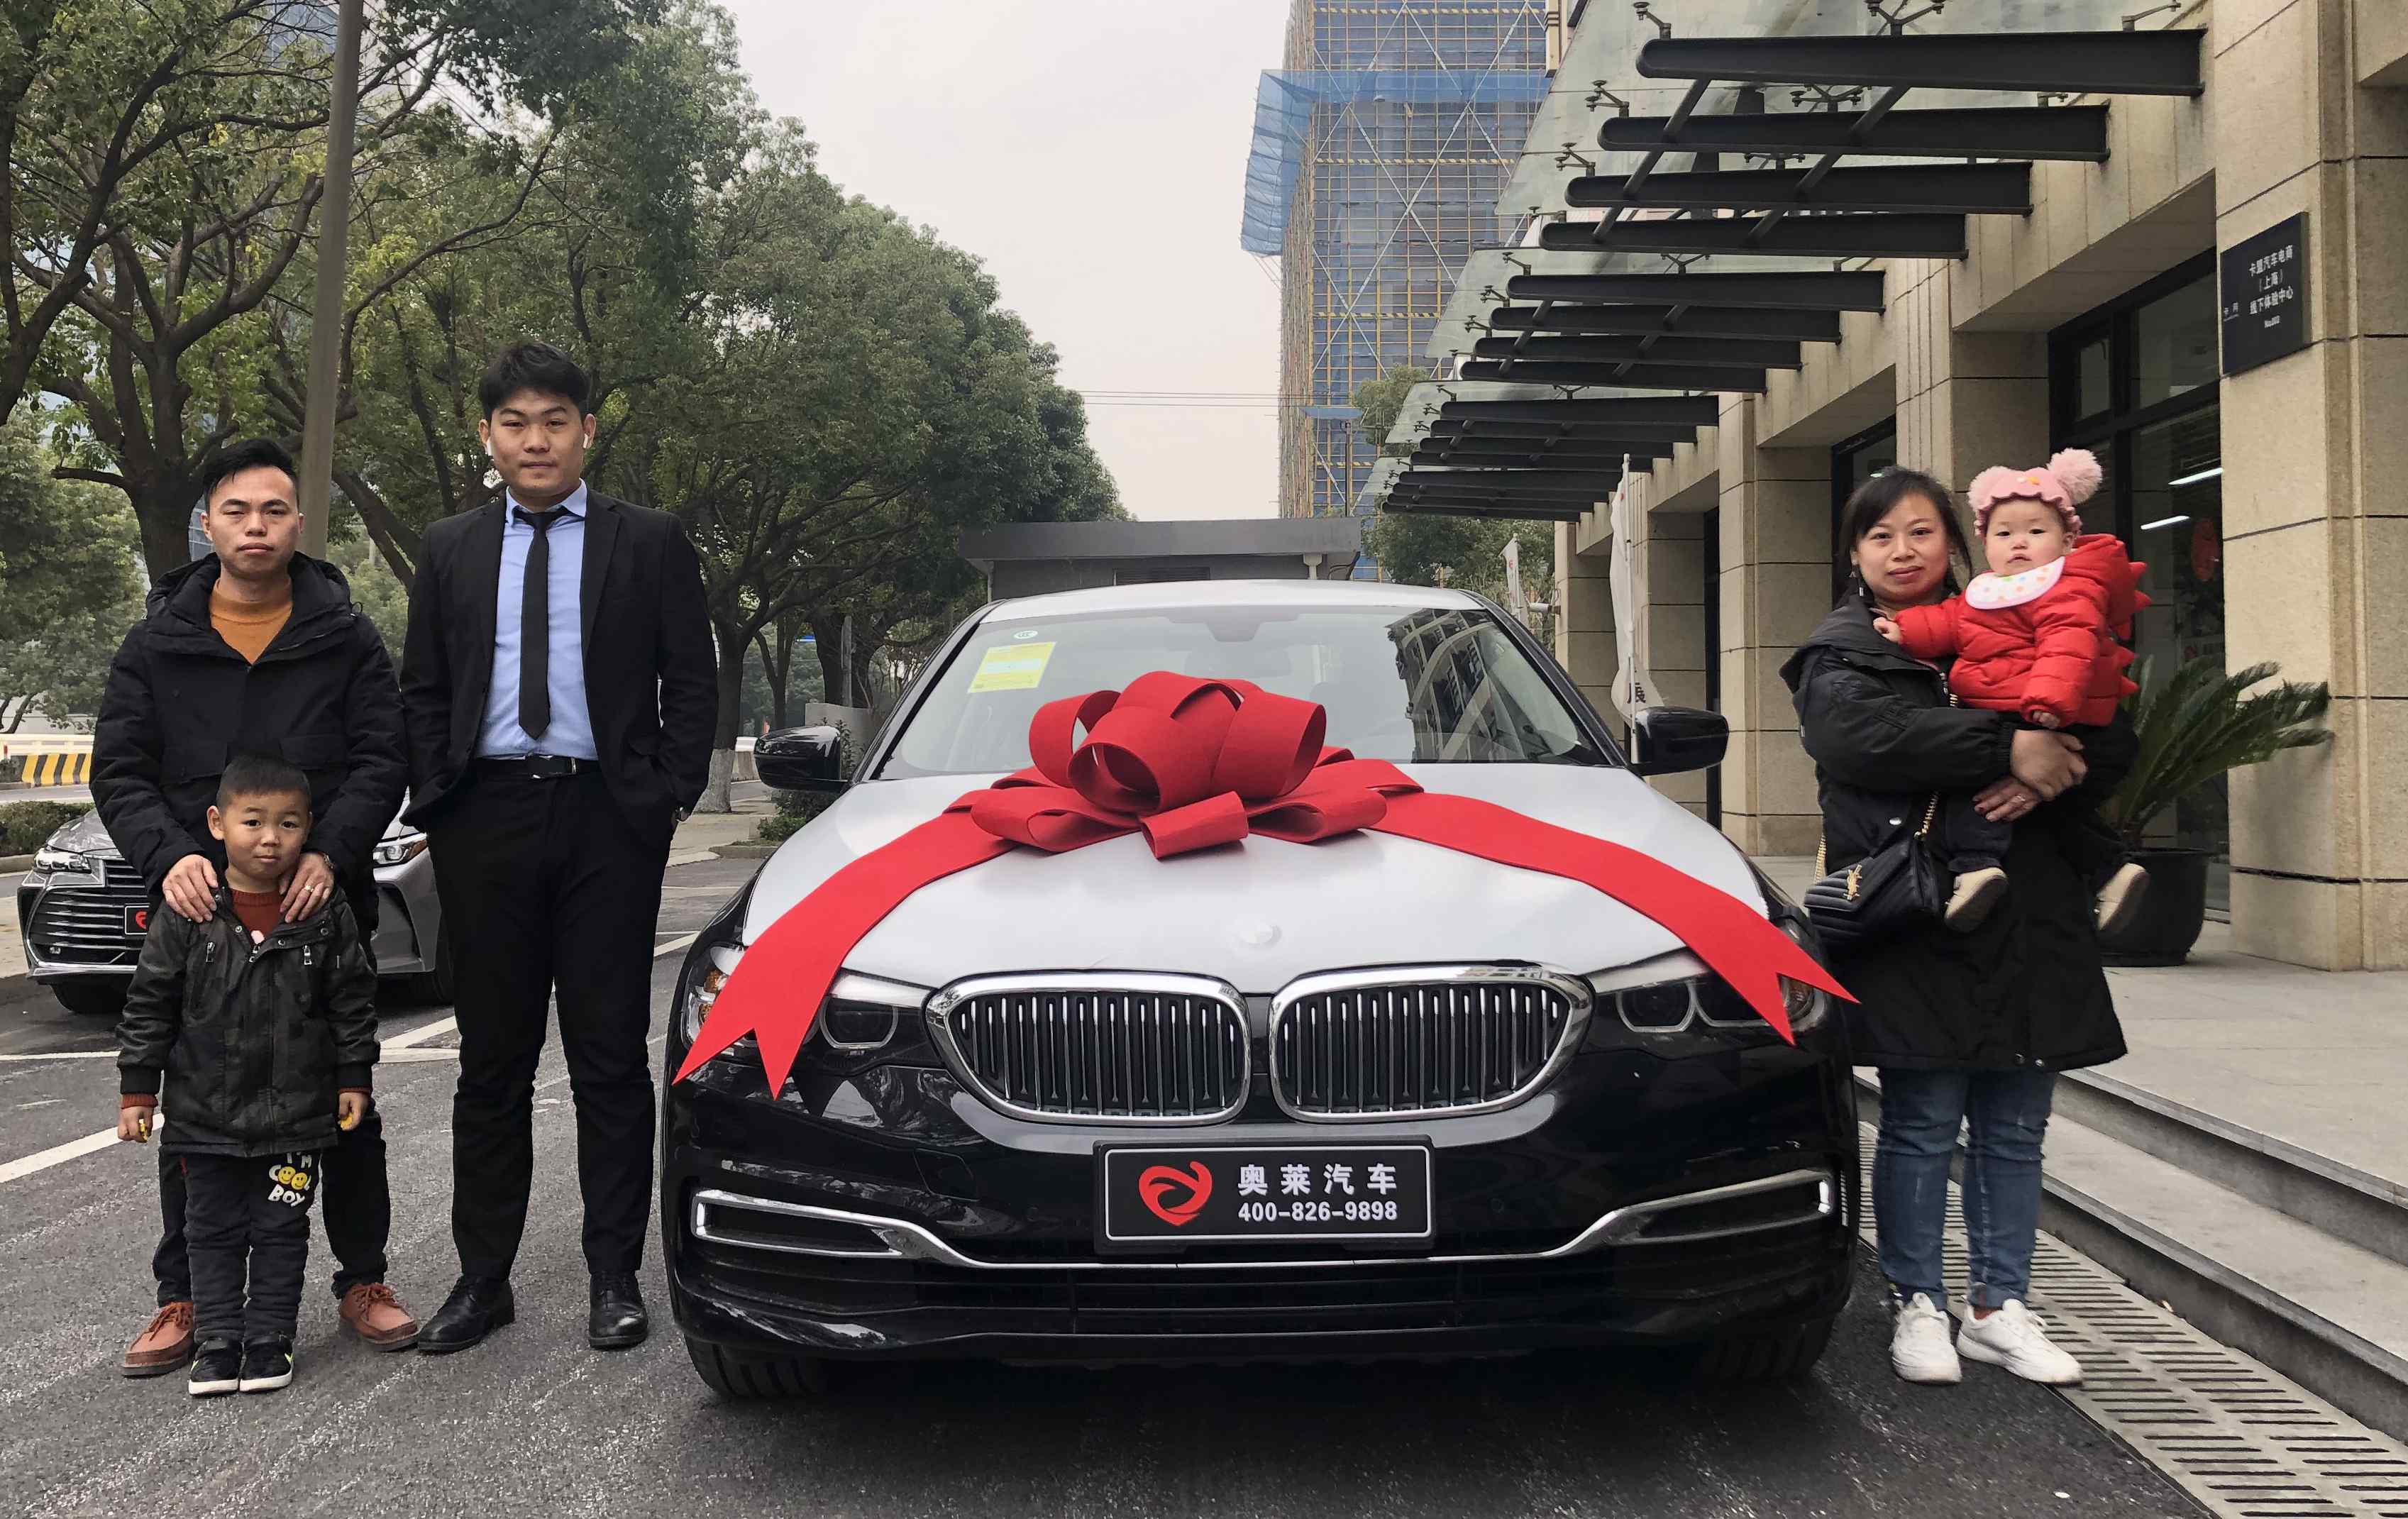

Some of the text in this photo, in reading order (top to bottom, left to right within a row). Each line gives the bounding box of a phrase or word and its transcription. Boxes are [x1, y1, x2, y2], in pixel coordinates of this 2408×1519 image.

[2249, 244, 2293, 277] 卡盟汽车电商
[2249, 285, 2294, 315] 线下体验中心
[1237, 1163, 1398, 1196] 奥莱汽车
[267, 1183, 306, 1208] BOY
[1237, 1200, 1398, 1222] 400-826-9898
